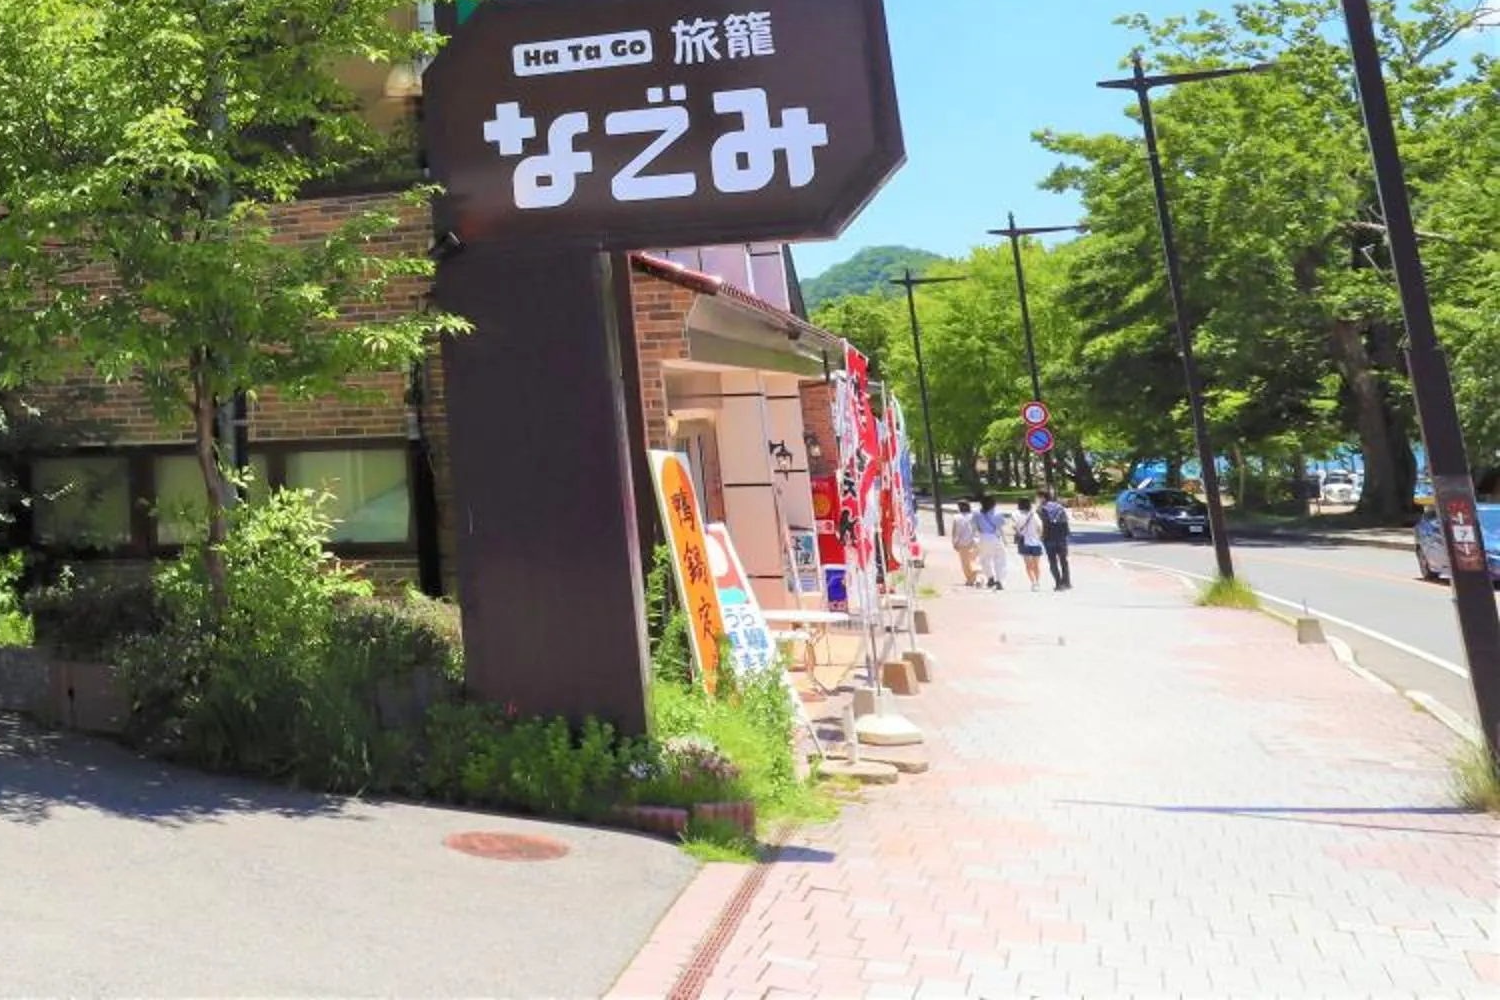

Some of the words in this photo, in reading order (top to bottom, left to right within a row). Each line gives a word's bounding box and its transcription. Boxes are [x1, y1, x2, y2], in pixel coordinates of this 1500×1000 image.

[523, 46, 559, 68] Ha
[568, 43, 602, 63] Ta
[610, 37, 647, 56] Go
[671, 11, 775, 65] 旅籠
[483, 84, 830, 209] なごみ
